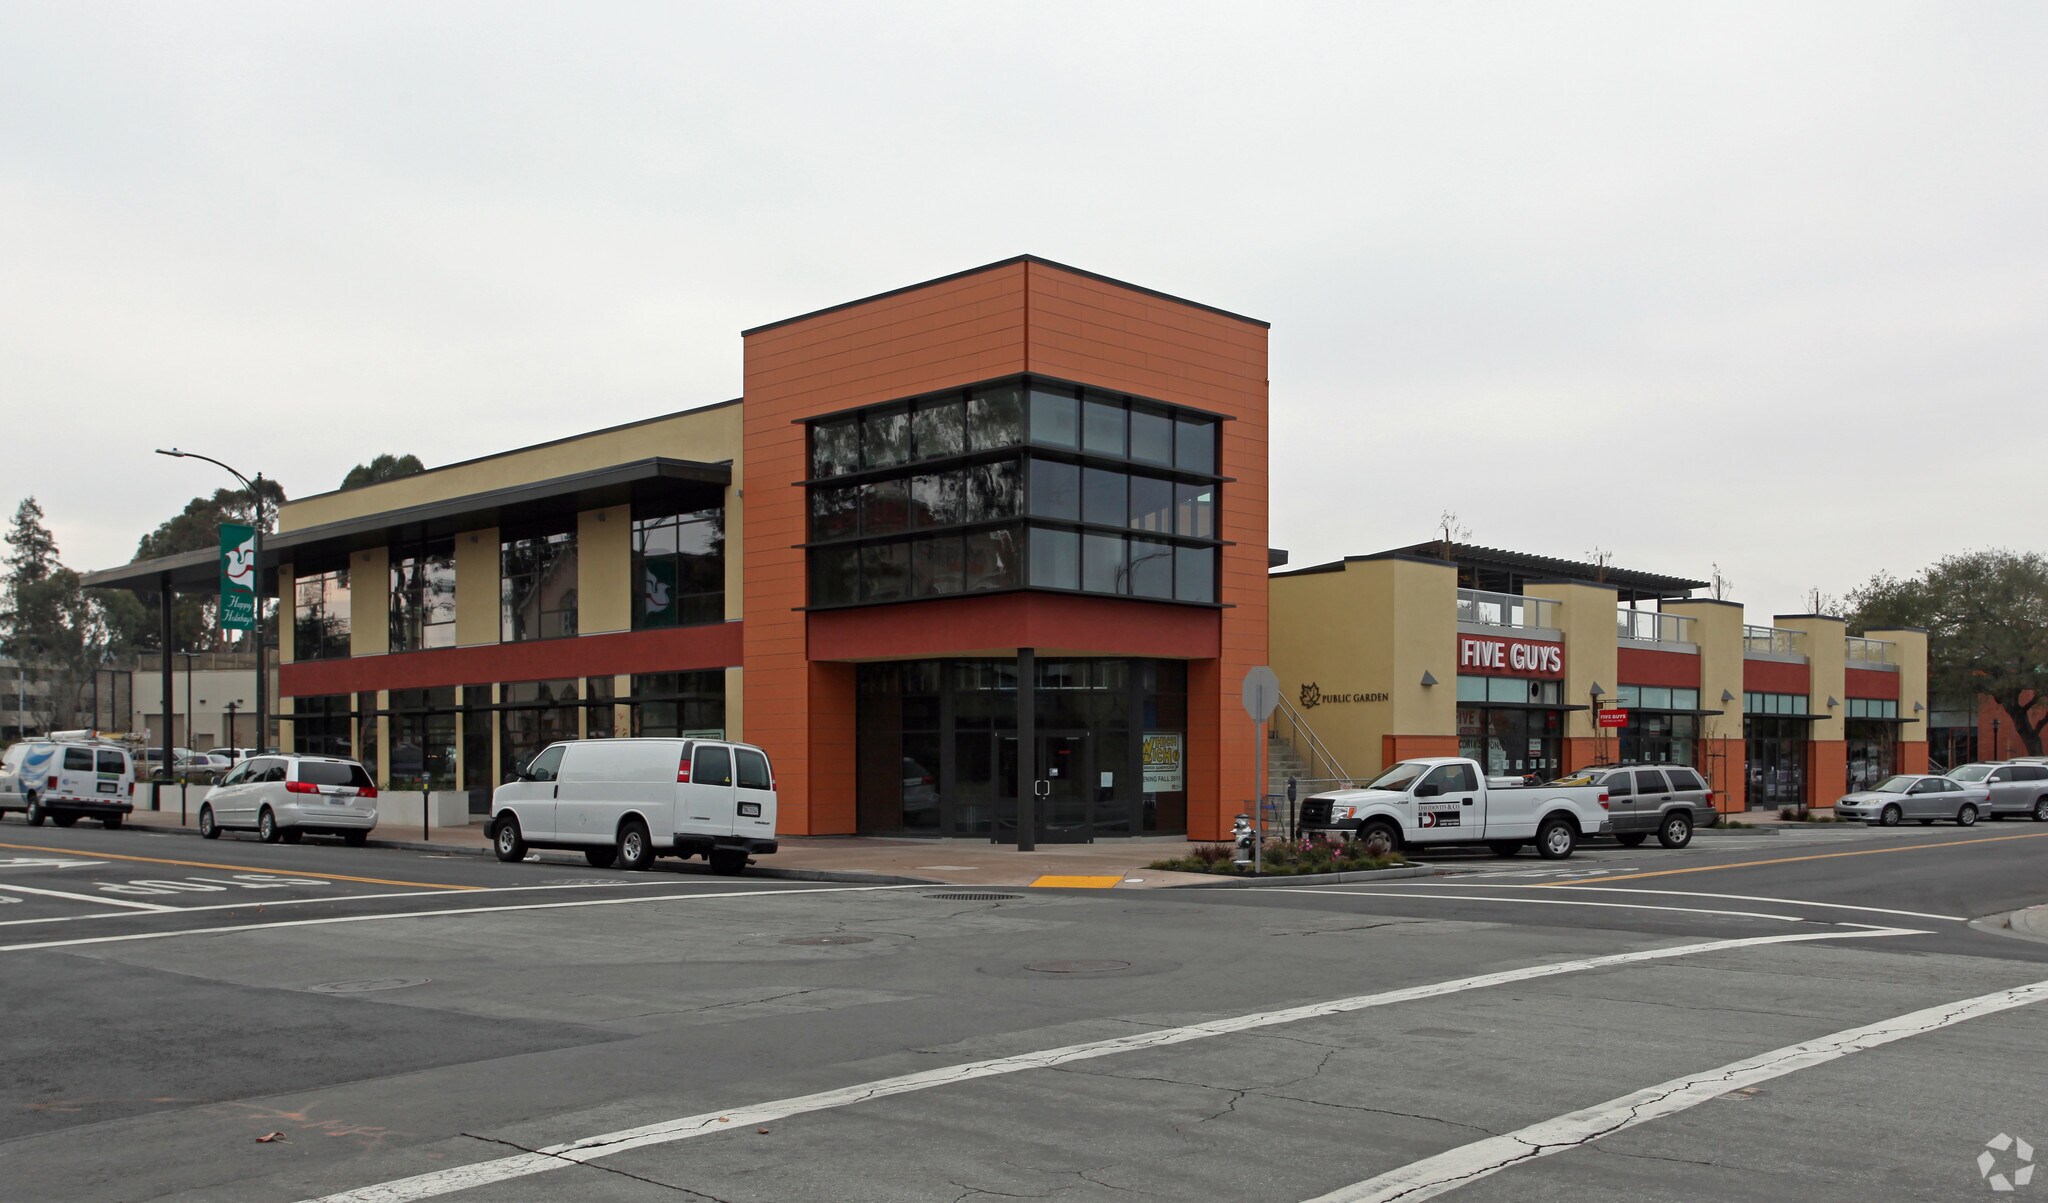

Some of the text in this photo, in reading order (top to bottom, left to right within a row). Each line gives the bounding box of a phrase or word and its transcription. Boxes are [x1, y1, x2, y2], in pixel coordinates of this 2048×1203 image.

[228, 595, 252, 612] Happy
[222, 609, 253, 627] Holidays
[1461, 639, 1561, 672] FIVE GUYS
[1322, 693, 1389, 703] PUBLIC GARDEN
